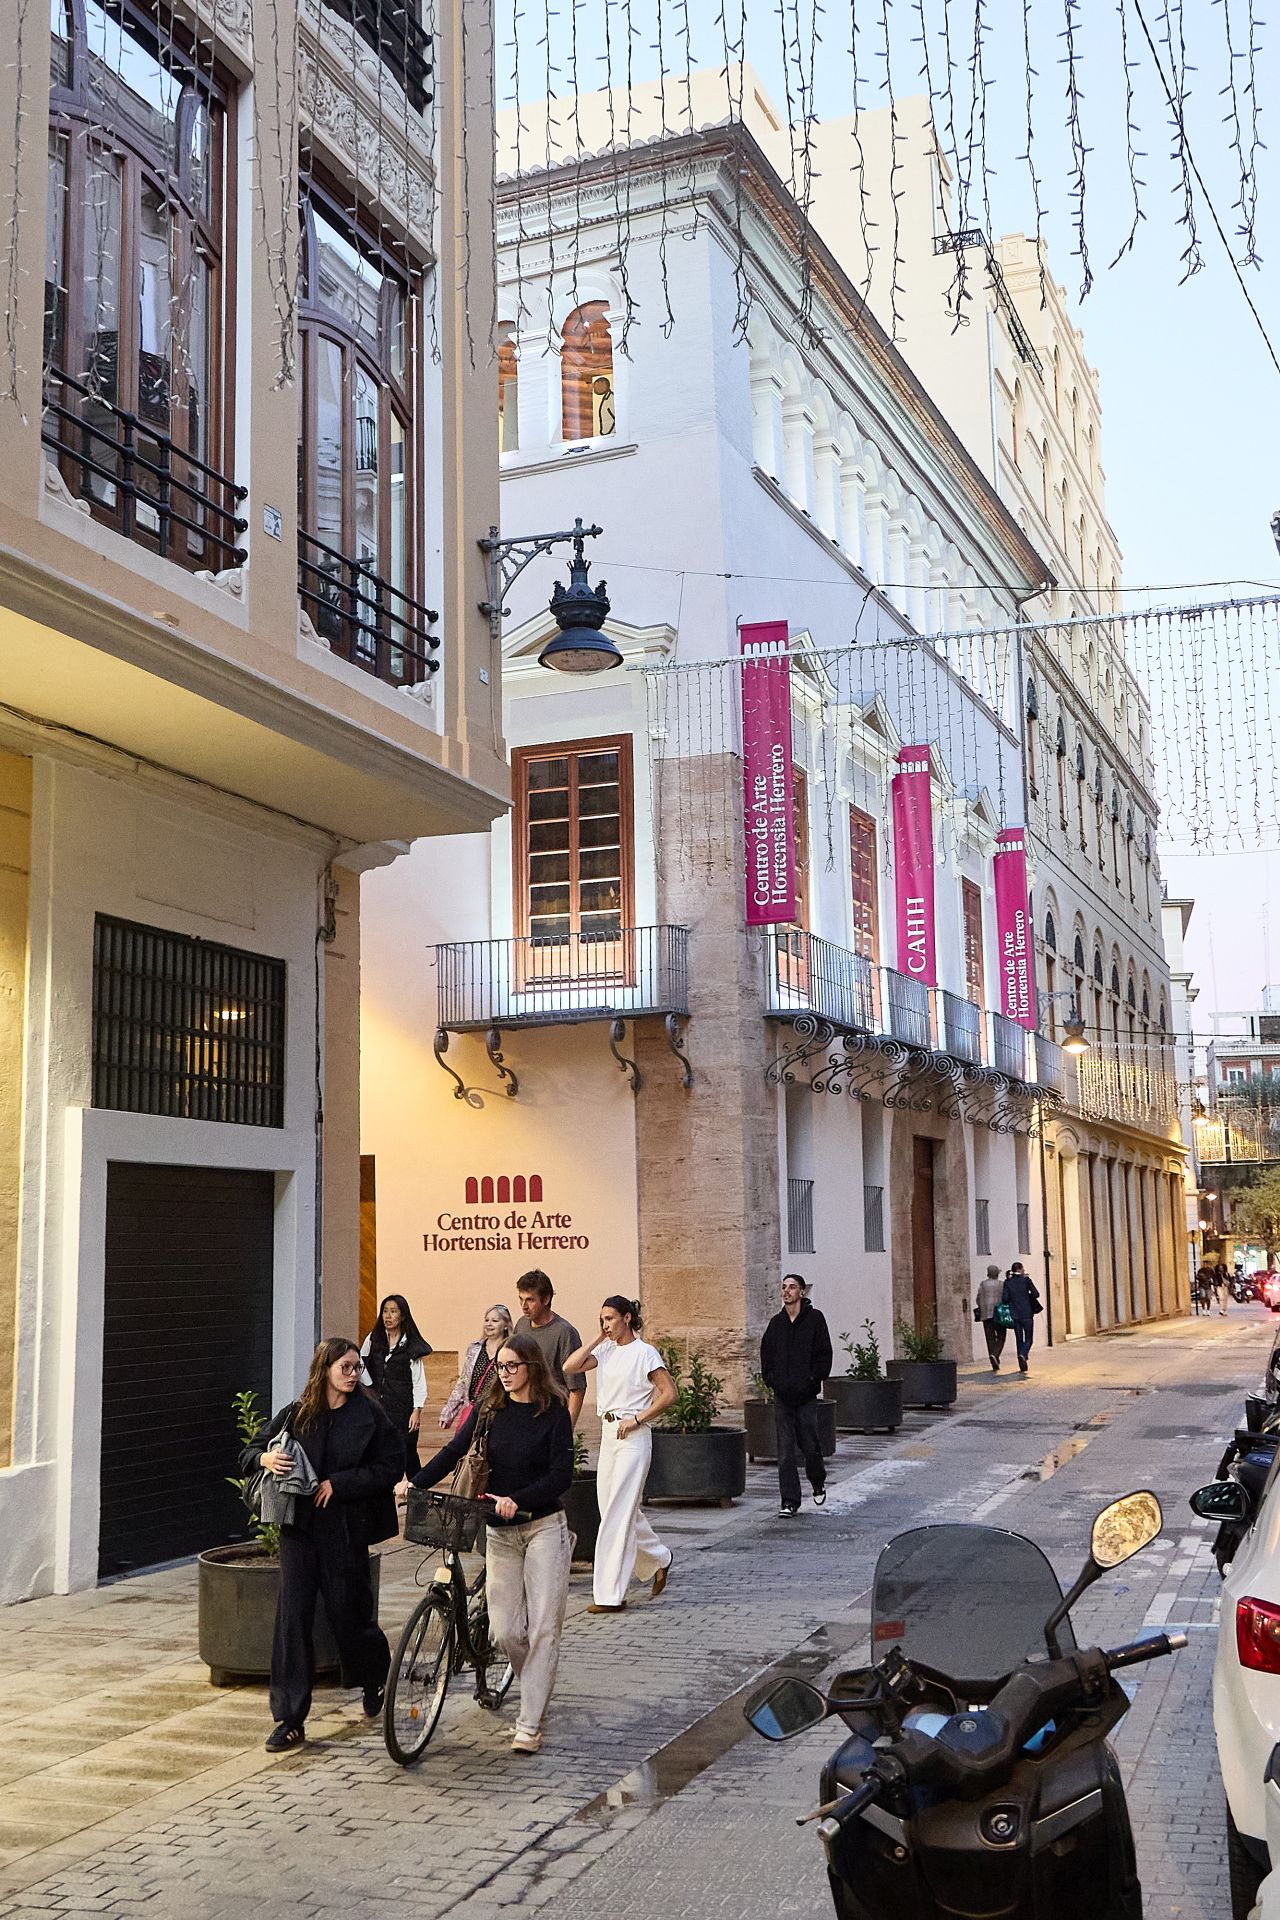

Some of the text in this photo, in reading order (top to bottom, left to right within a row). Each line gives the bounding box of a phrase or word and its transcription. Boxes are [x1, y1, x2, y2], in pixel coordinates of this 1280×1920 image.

[752, 774, 769, 906] Centro de Arte
[769, 743, 787, 905] Hortensia Herrero
[907, 897, 926, 973] CAHH
[1004, 931, 1018, 1019] Centro de Arte
[1015, 910, 1029, 1018] Hortensia Herrero
[422, 1232, 589, 1251] Hortensia Herrero
[437, 1211, 572, 1231] Centro de Arte
